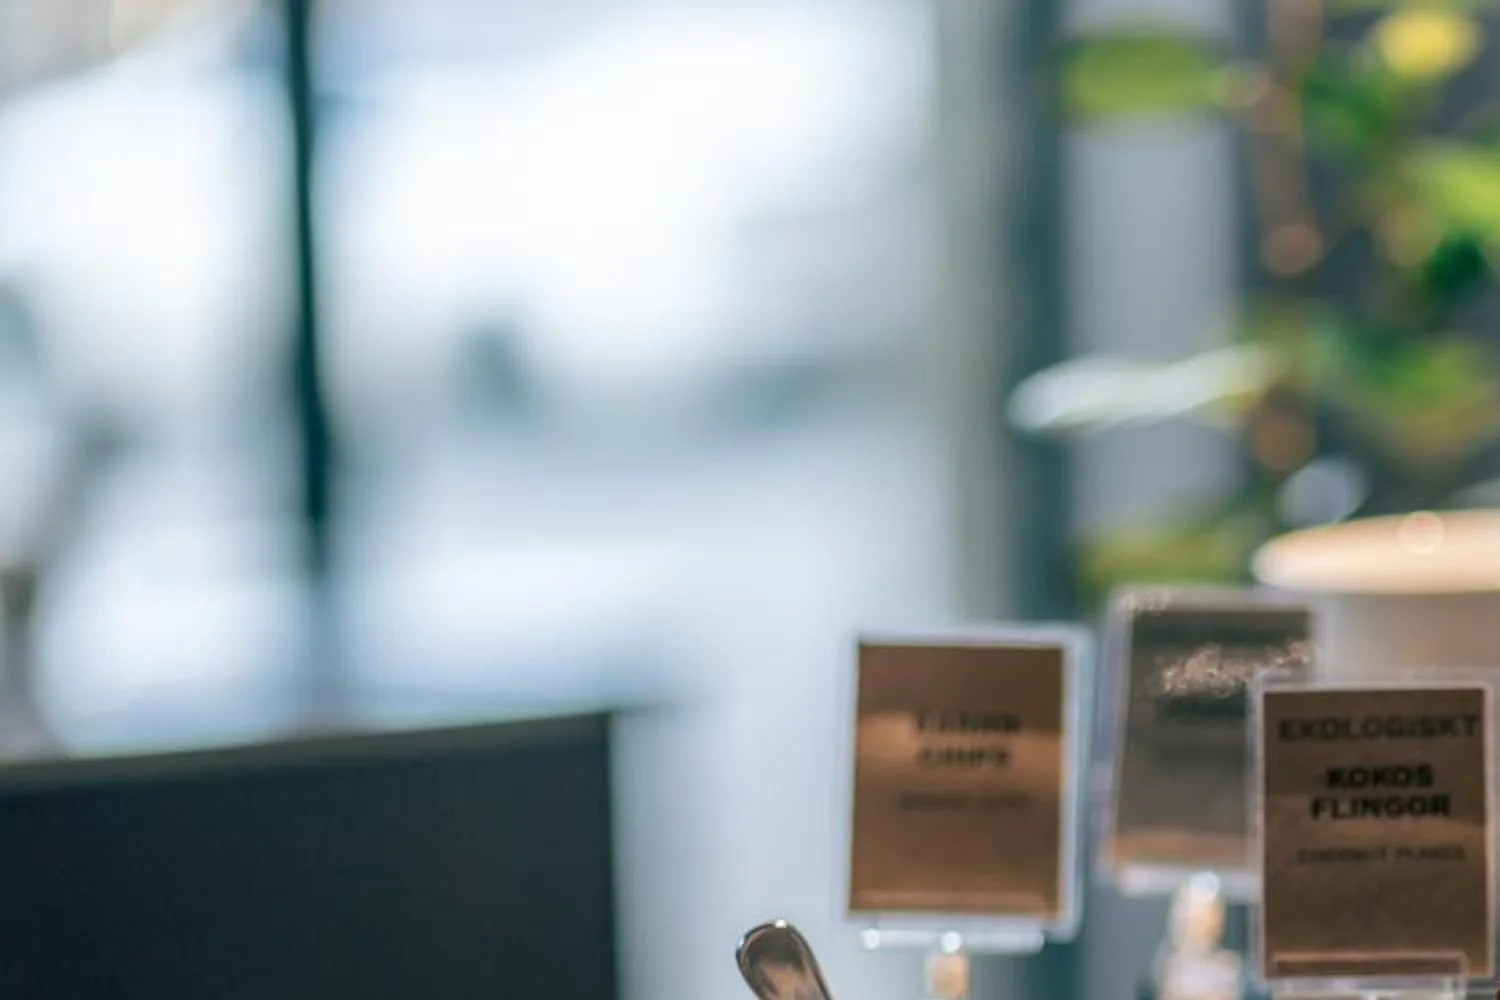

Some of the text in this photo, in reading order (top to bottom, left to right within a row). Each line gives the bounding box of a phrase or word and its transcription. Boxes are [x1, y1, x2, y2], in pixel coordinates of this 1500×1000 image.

[1279, 714, 1477, 738] EKOLOGISKT
[1326, 765, 1434, 788] KOKOS
[1310, 794, 1451, 820] FLINGOR
